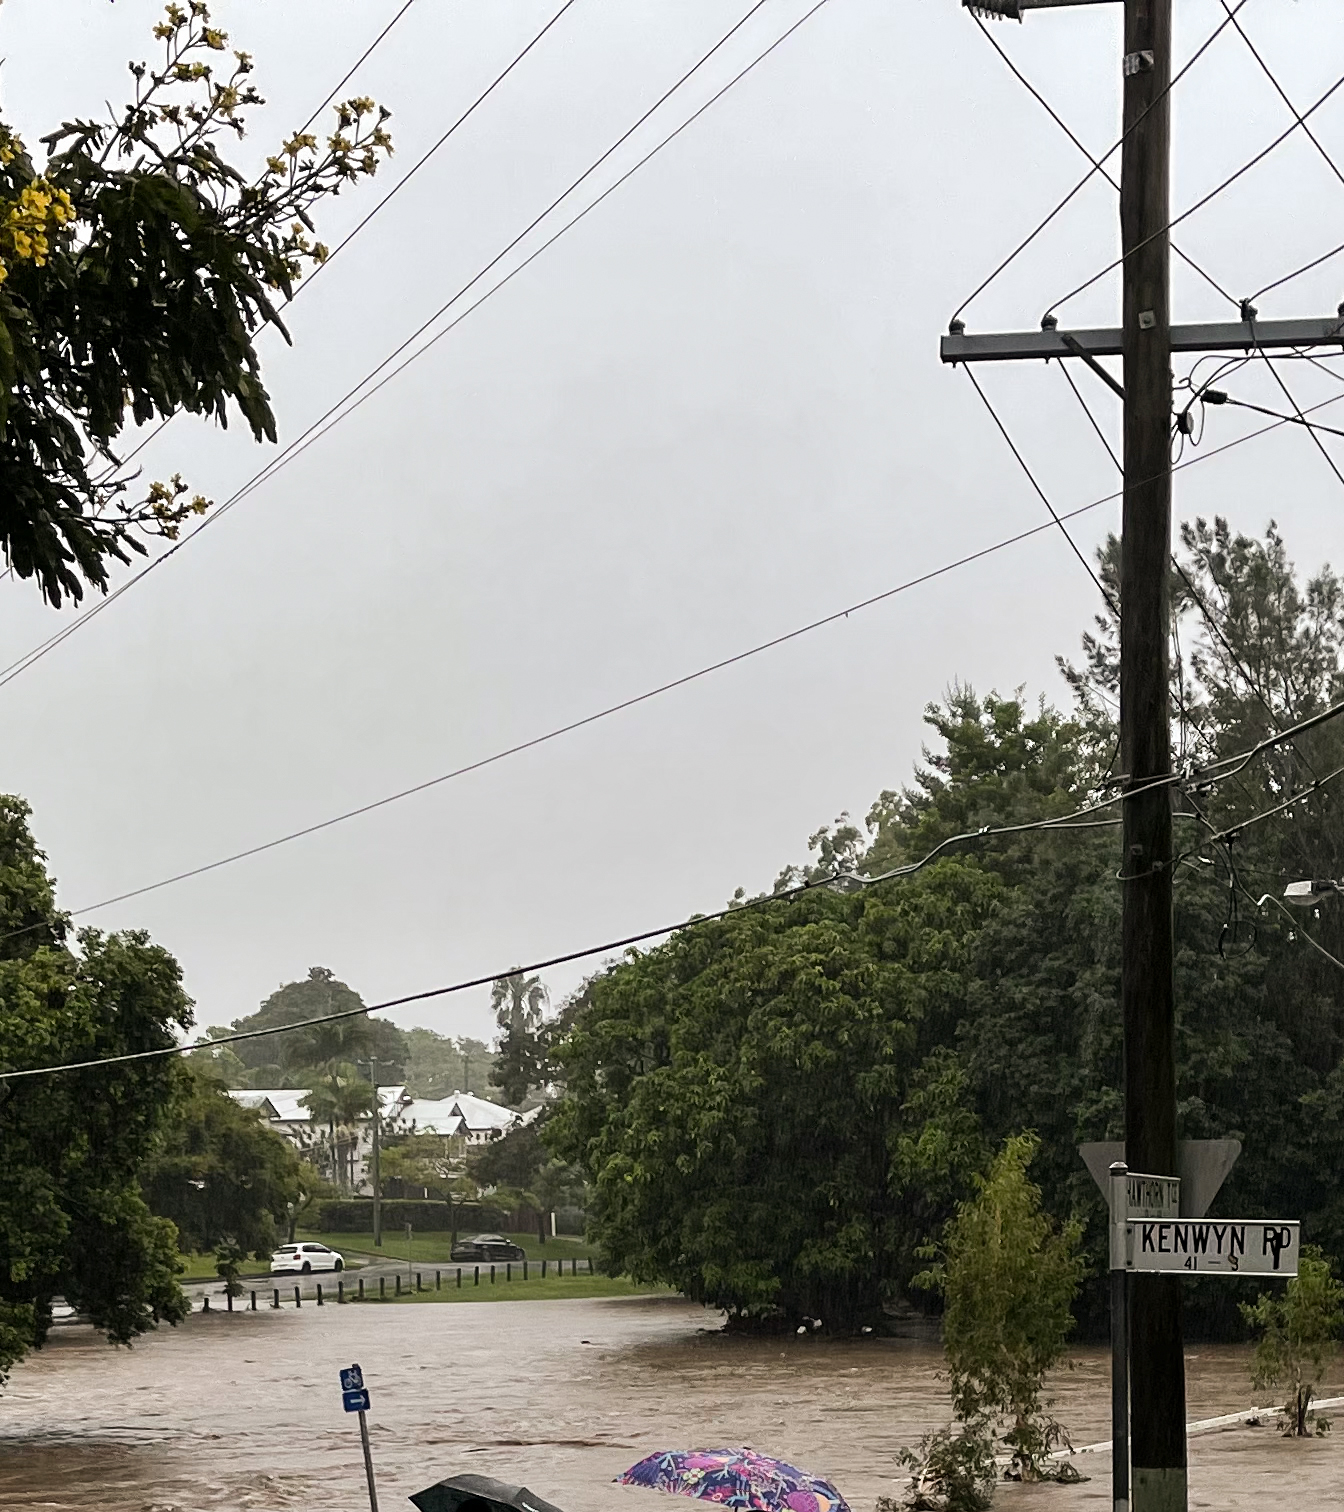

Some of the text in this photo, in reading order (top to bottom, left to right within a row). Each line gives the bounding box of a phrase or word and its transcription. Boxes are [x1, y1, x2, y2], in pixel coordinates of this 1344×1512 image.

[1142, 1224, 1291, 1256] KENWYN RD
[1184, 1255, 1197, 1270] 41
